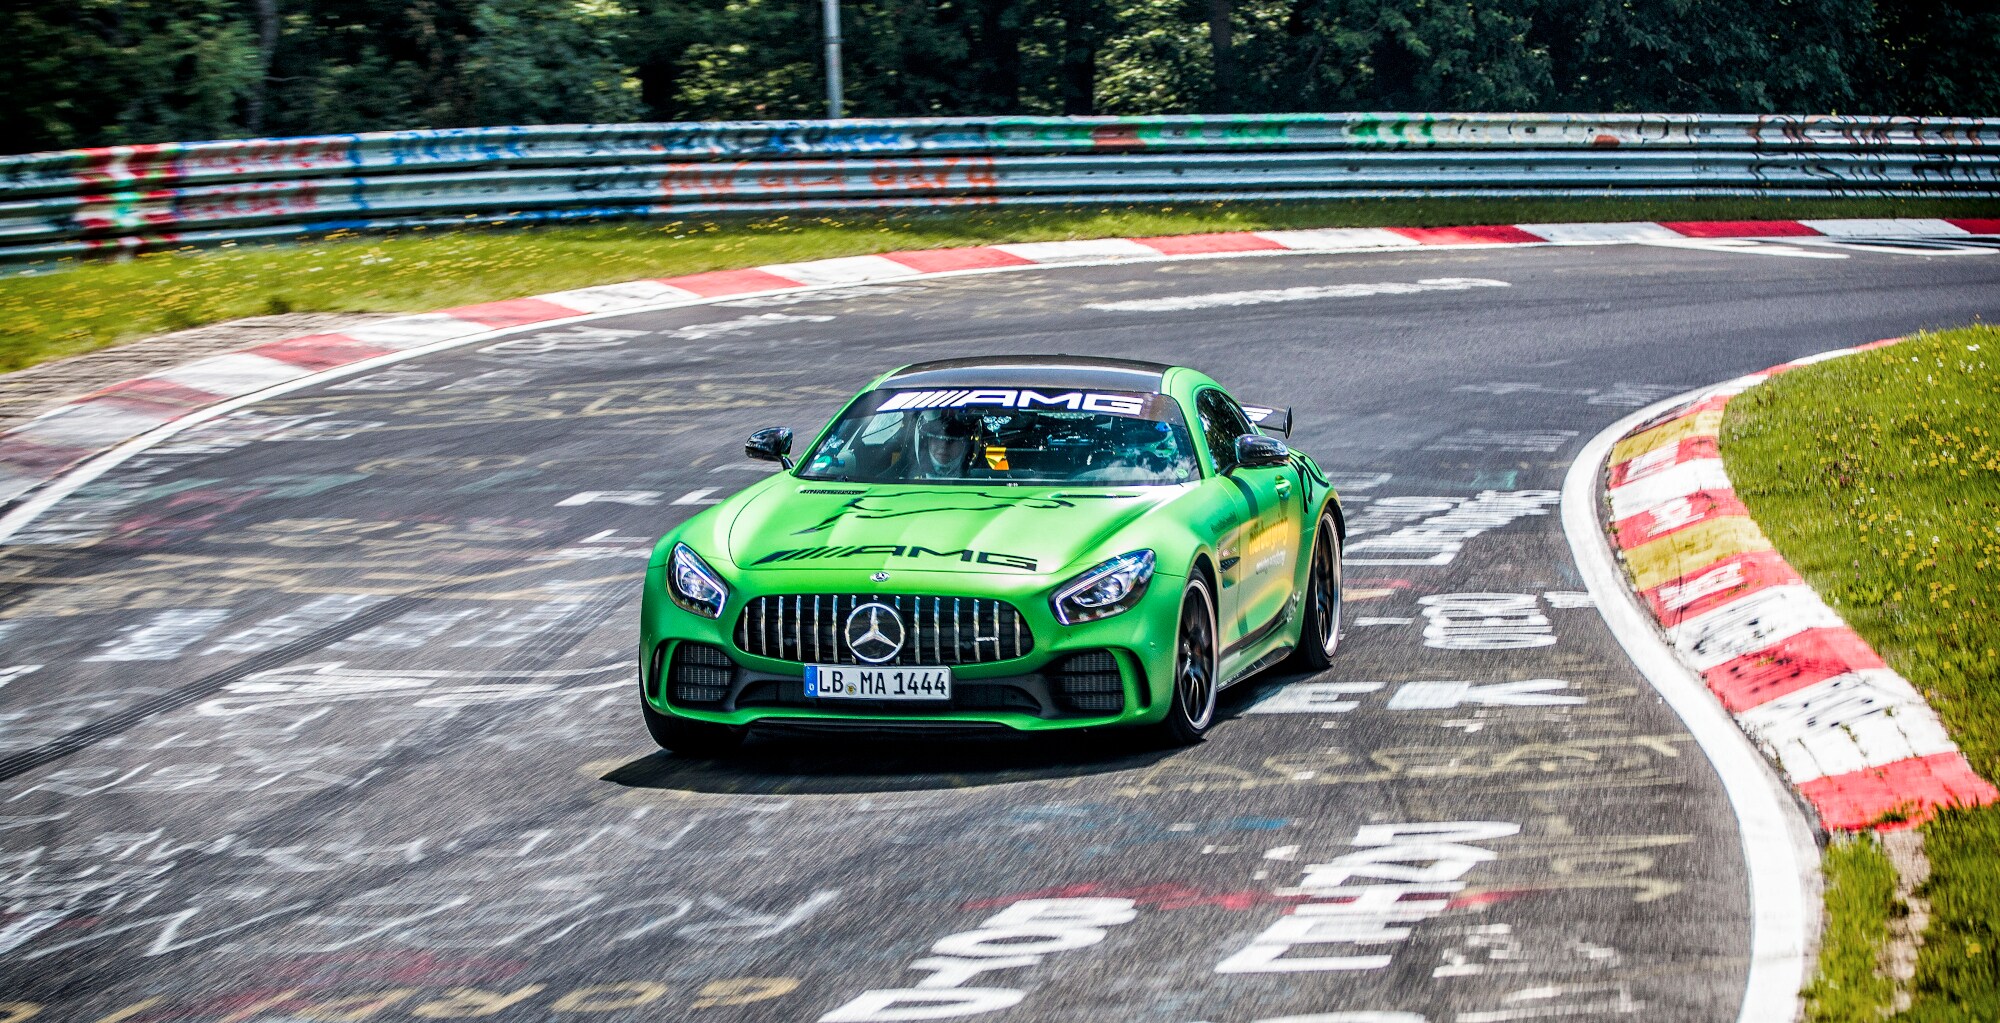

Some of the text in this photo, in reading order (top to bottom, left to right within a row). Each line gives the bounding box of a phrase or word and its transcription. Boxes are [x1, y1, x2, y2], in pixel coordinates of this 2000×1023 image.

[819, 670, 844, 693] LB
[860, 671, 886, 695] MA
[893, 672, 947, 696] 1444
